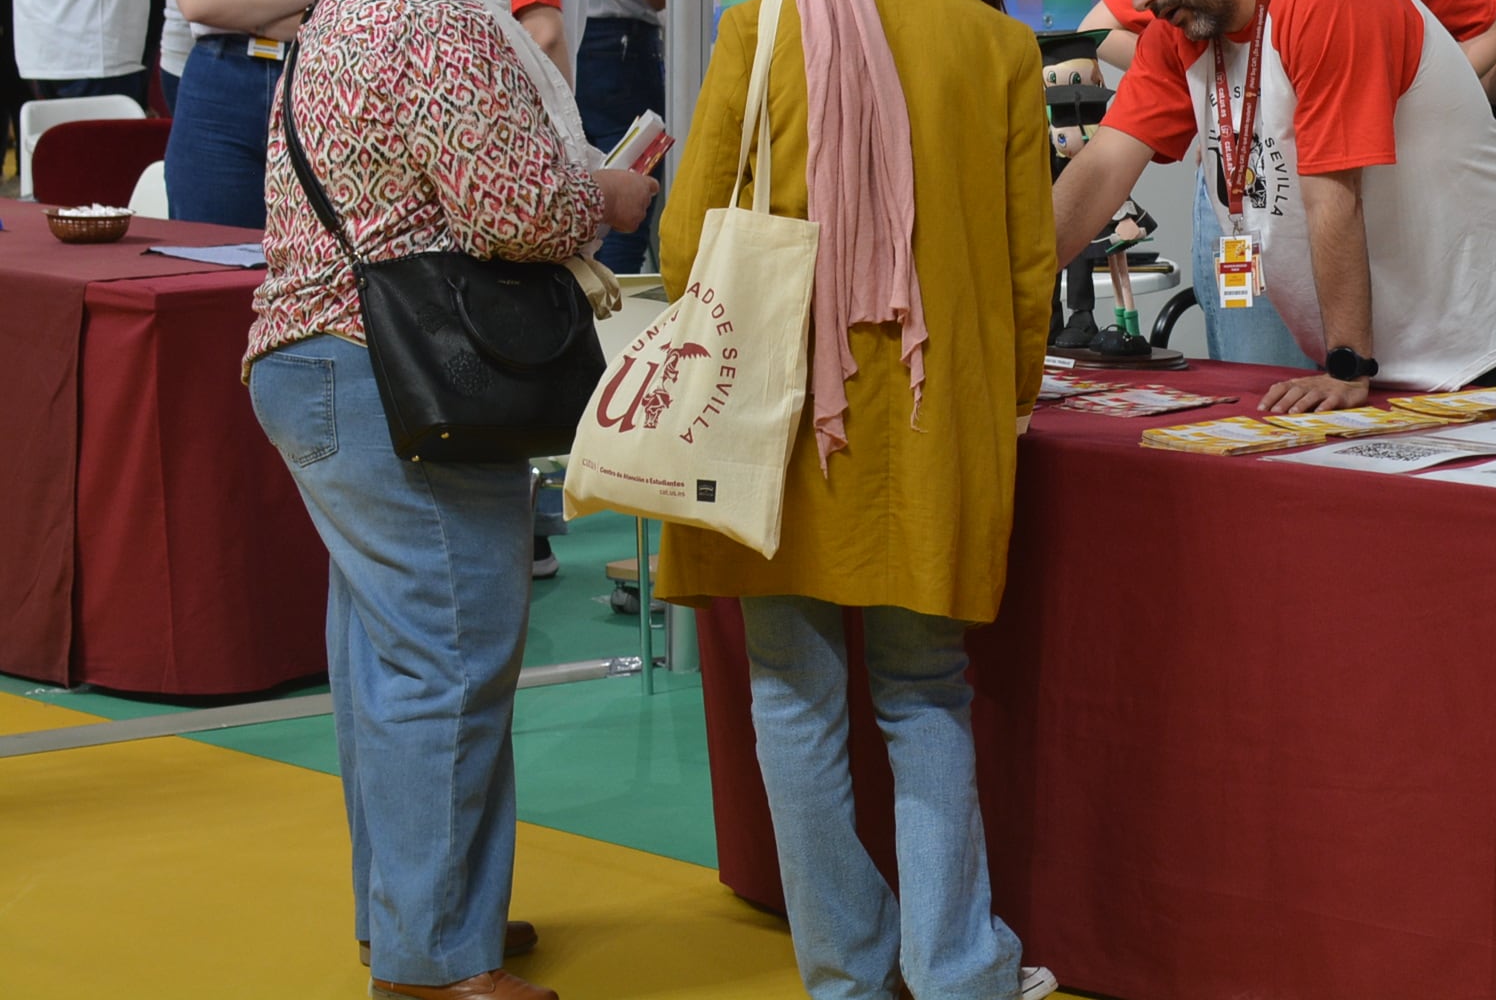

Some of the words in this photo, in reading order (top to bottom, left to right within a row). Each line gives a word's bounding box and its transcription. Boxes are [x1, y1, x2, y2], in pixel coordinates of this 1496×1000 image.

[1265, 136, 1291, 217] SEVILLA
[711, 303, 734, 337] DE
[680, 347, 738, 444] SEVILLA
